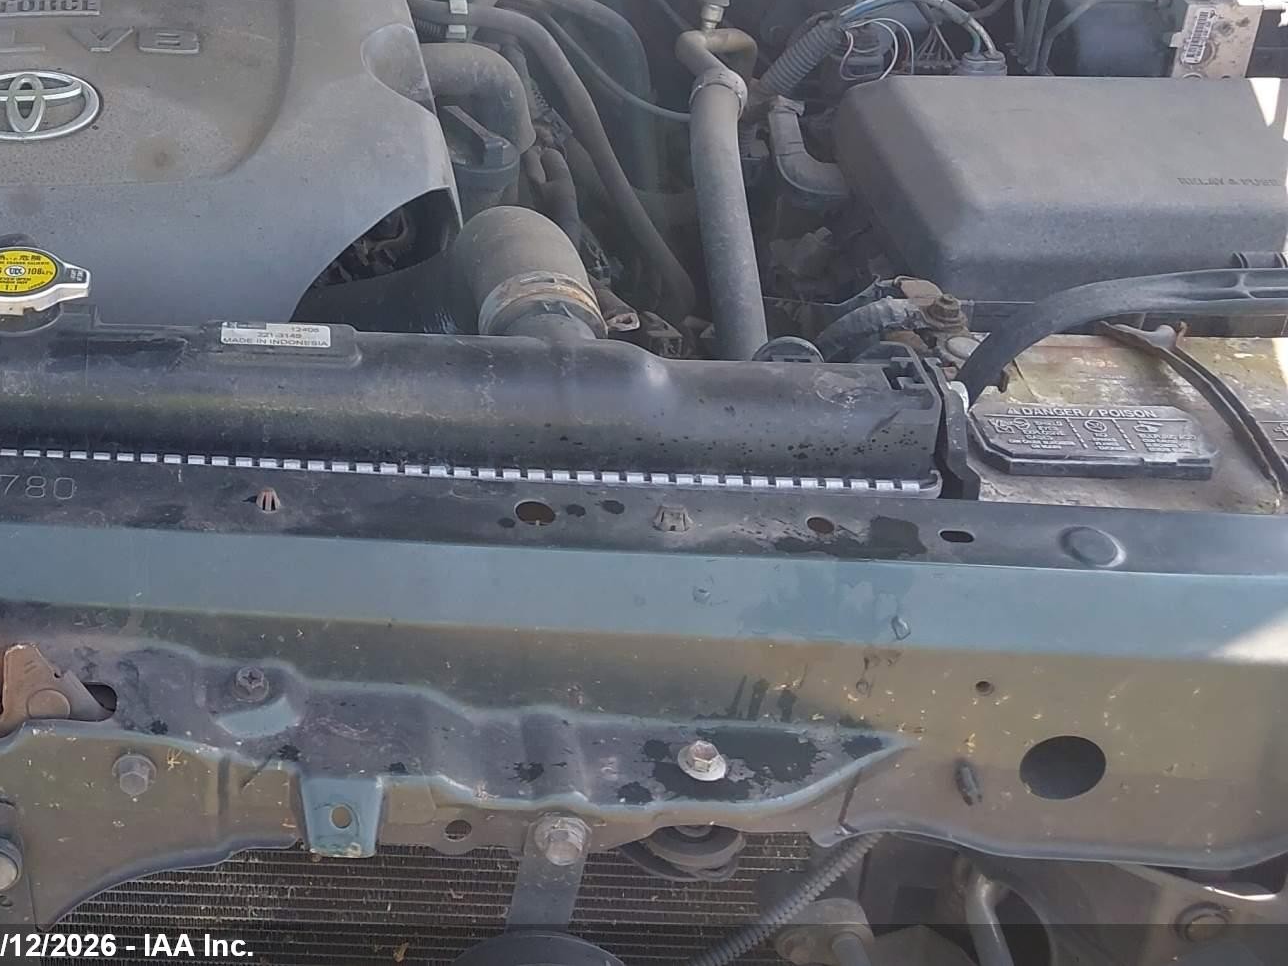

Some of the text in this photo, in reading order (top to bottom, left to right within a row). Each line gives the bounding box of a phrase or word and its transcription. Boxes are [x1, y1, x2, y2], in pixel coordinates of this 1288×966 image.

[69, 26, 201, 55] V8
[269, 338, 328, 346] INDONESIA
[1021, 407, 1083, 417] DANGER
[1097, 408, 1158, 418] POISON
